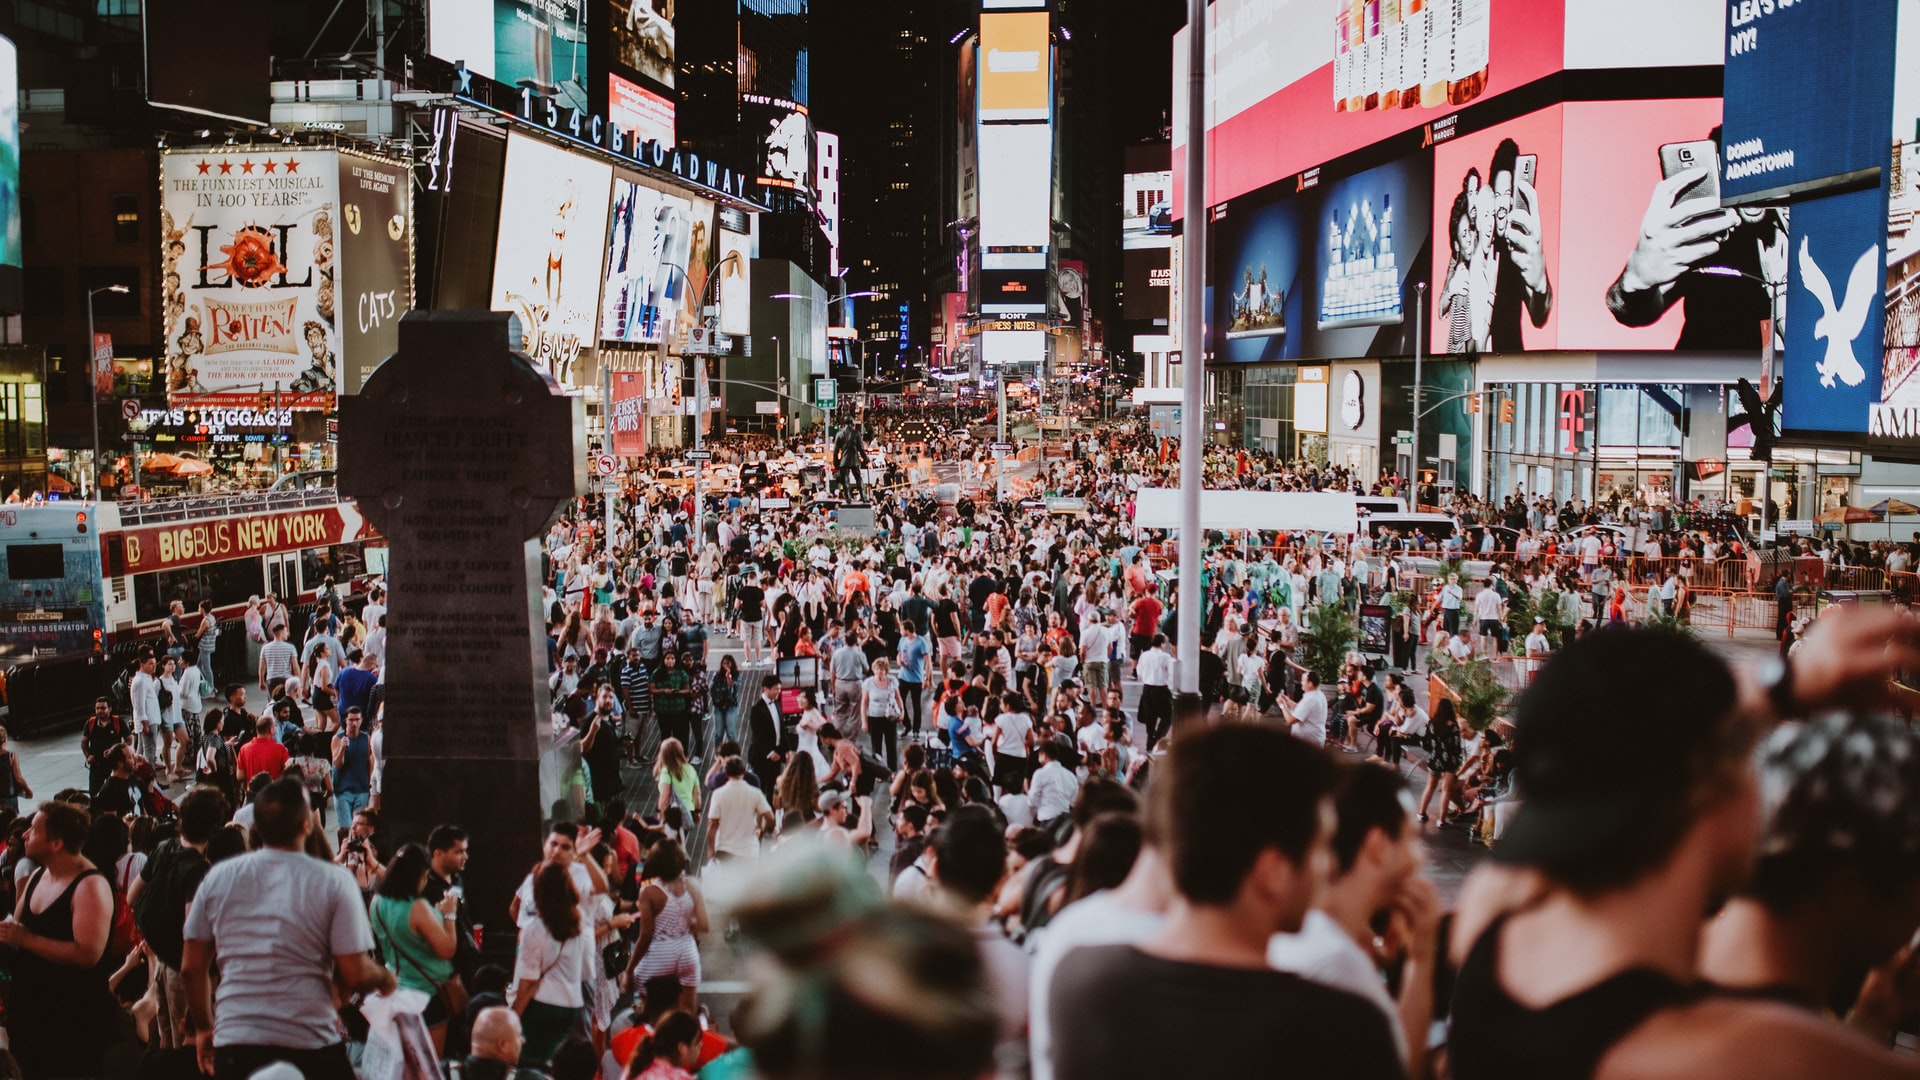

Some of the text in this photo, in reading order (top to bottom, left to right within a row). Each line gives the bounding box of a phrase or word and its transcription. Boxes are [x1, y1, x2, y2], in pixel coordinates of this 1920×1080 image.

[1730, 26, 1757, 57] NY!
[1726, 137, 1764, 161] DONNA
[612, 122, 746, 199] BROADWAY
[352, 166, 396, 185] LET THE MEMORY
[173, 177, 323, 191] THE FUNNIEST MUSICAL
[360, 179, 372, 190] LIVE
[197, 195, 213, 207] IN
[217, 193, 246, 207] 400
[1150, 269, 1171, 278] IT JUS
[217, 303, 285, 313] SOMETHING
[359, 289, 395, 334] CATS
[614, 397, 643, 416] JERSEY
[139, 408, 293, 427] IFTS LUGGAGE
[617, 414, 639, 432] BOYS
[1560, 390, 1584, 453] T
[155, 433, 176, 442] Nikon
[181, 434, 207, 442] Canon
[213, 434, 239, 442] SONY
[244, 434, 265, 442] BOWER
[384, 431, 450, 447] FRANCIS
[471, 431, 528, 448] DUFFY
[237, 518, 279, 551] NEW
[283, 513, 328, 545] YORK
[405, 560, 511, 571] A LIFE OF SERVICE
[400, 583, 514, 595] GOD AND COUNTRY
[0, 623, 89, 634] NE WORLD OBSERVATORY
